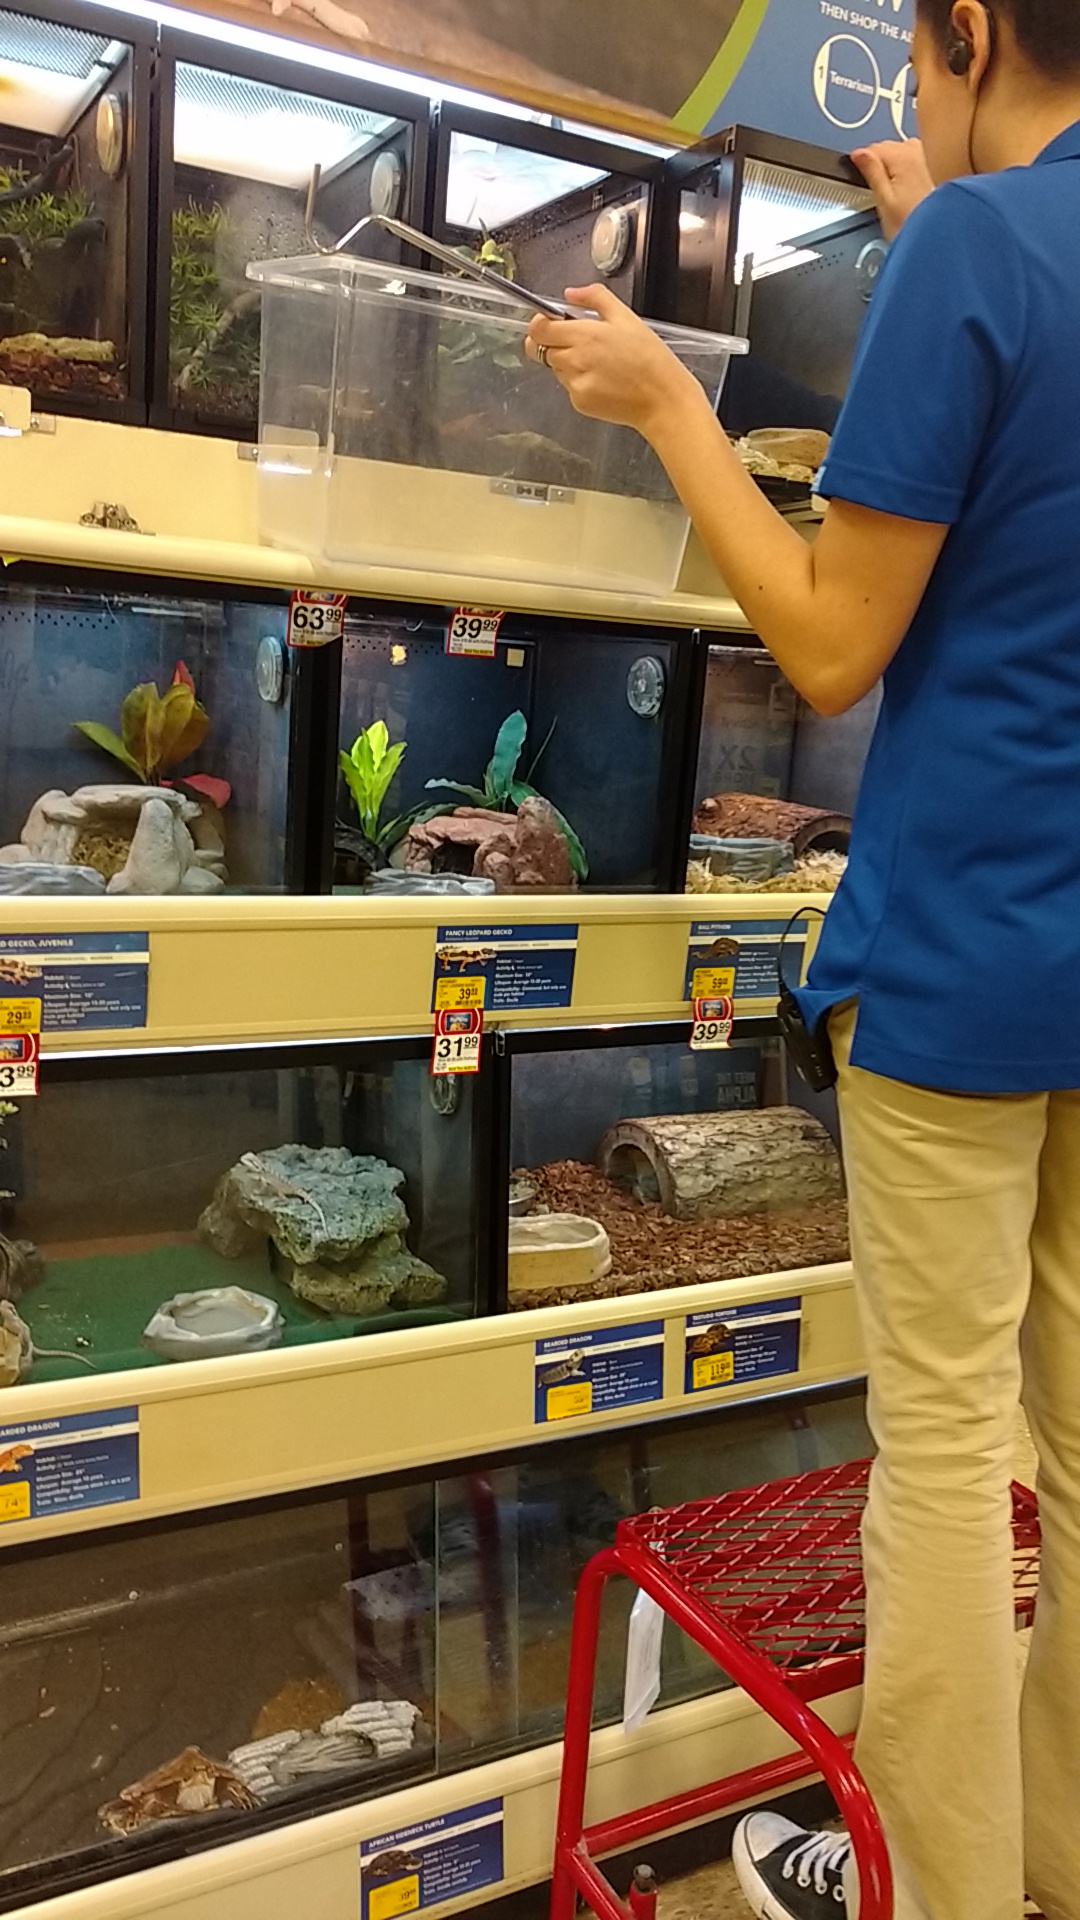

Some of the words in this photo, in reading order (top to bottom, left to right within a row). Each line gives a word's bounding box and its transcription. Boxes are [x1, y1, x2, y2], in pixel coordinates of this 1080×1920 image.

[819, 1, 849, 21] THEN
[849, 11, 878, 31] SHOP
[880, 21, 900, 39] THE
[818, 66, 824, 79] 1
[830, 70, 874, 95] Terrarium
[895, 90, 902, 103] 2
[38, 939, 74, 947] JUVENILE
[544, 1339, 569, 1348] BEARDED
[569, 1335, 593, 1344] DRAGON
[27, 1421, 60, 1432] DRAGON
[369, 1835, 395, 1848] AFRICAN
[424, 1818, 445, 1830] TURTLE
